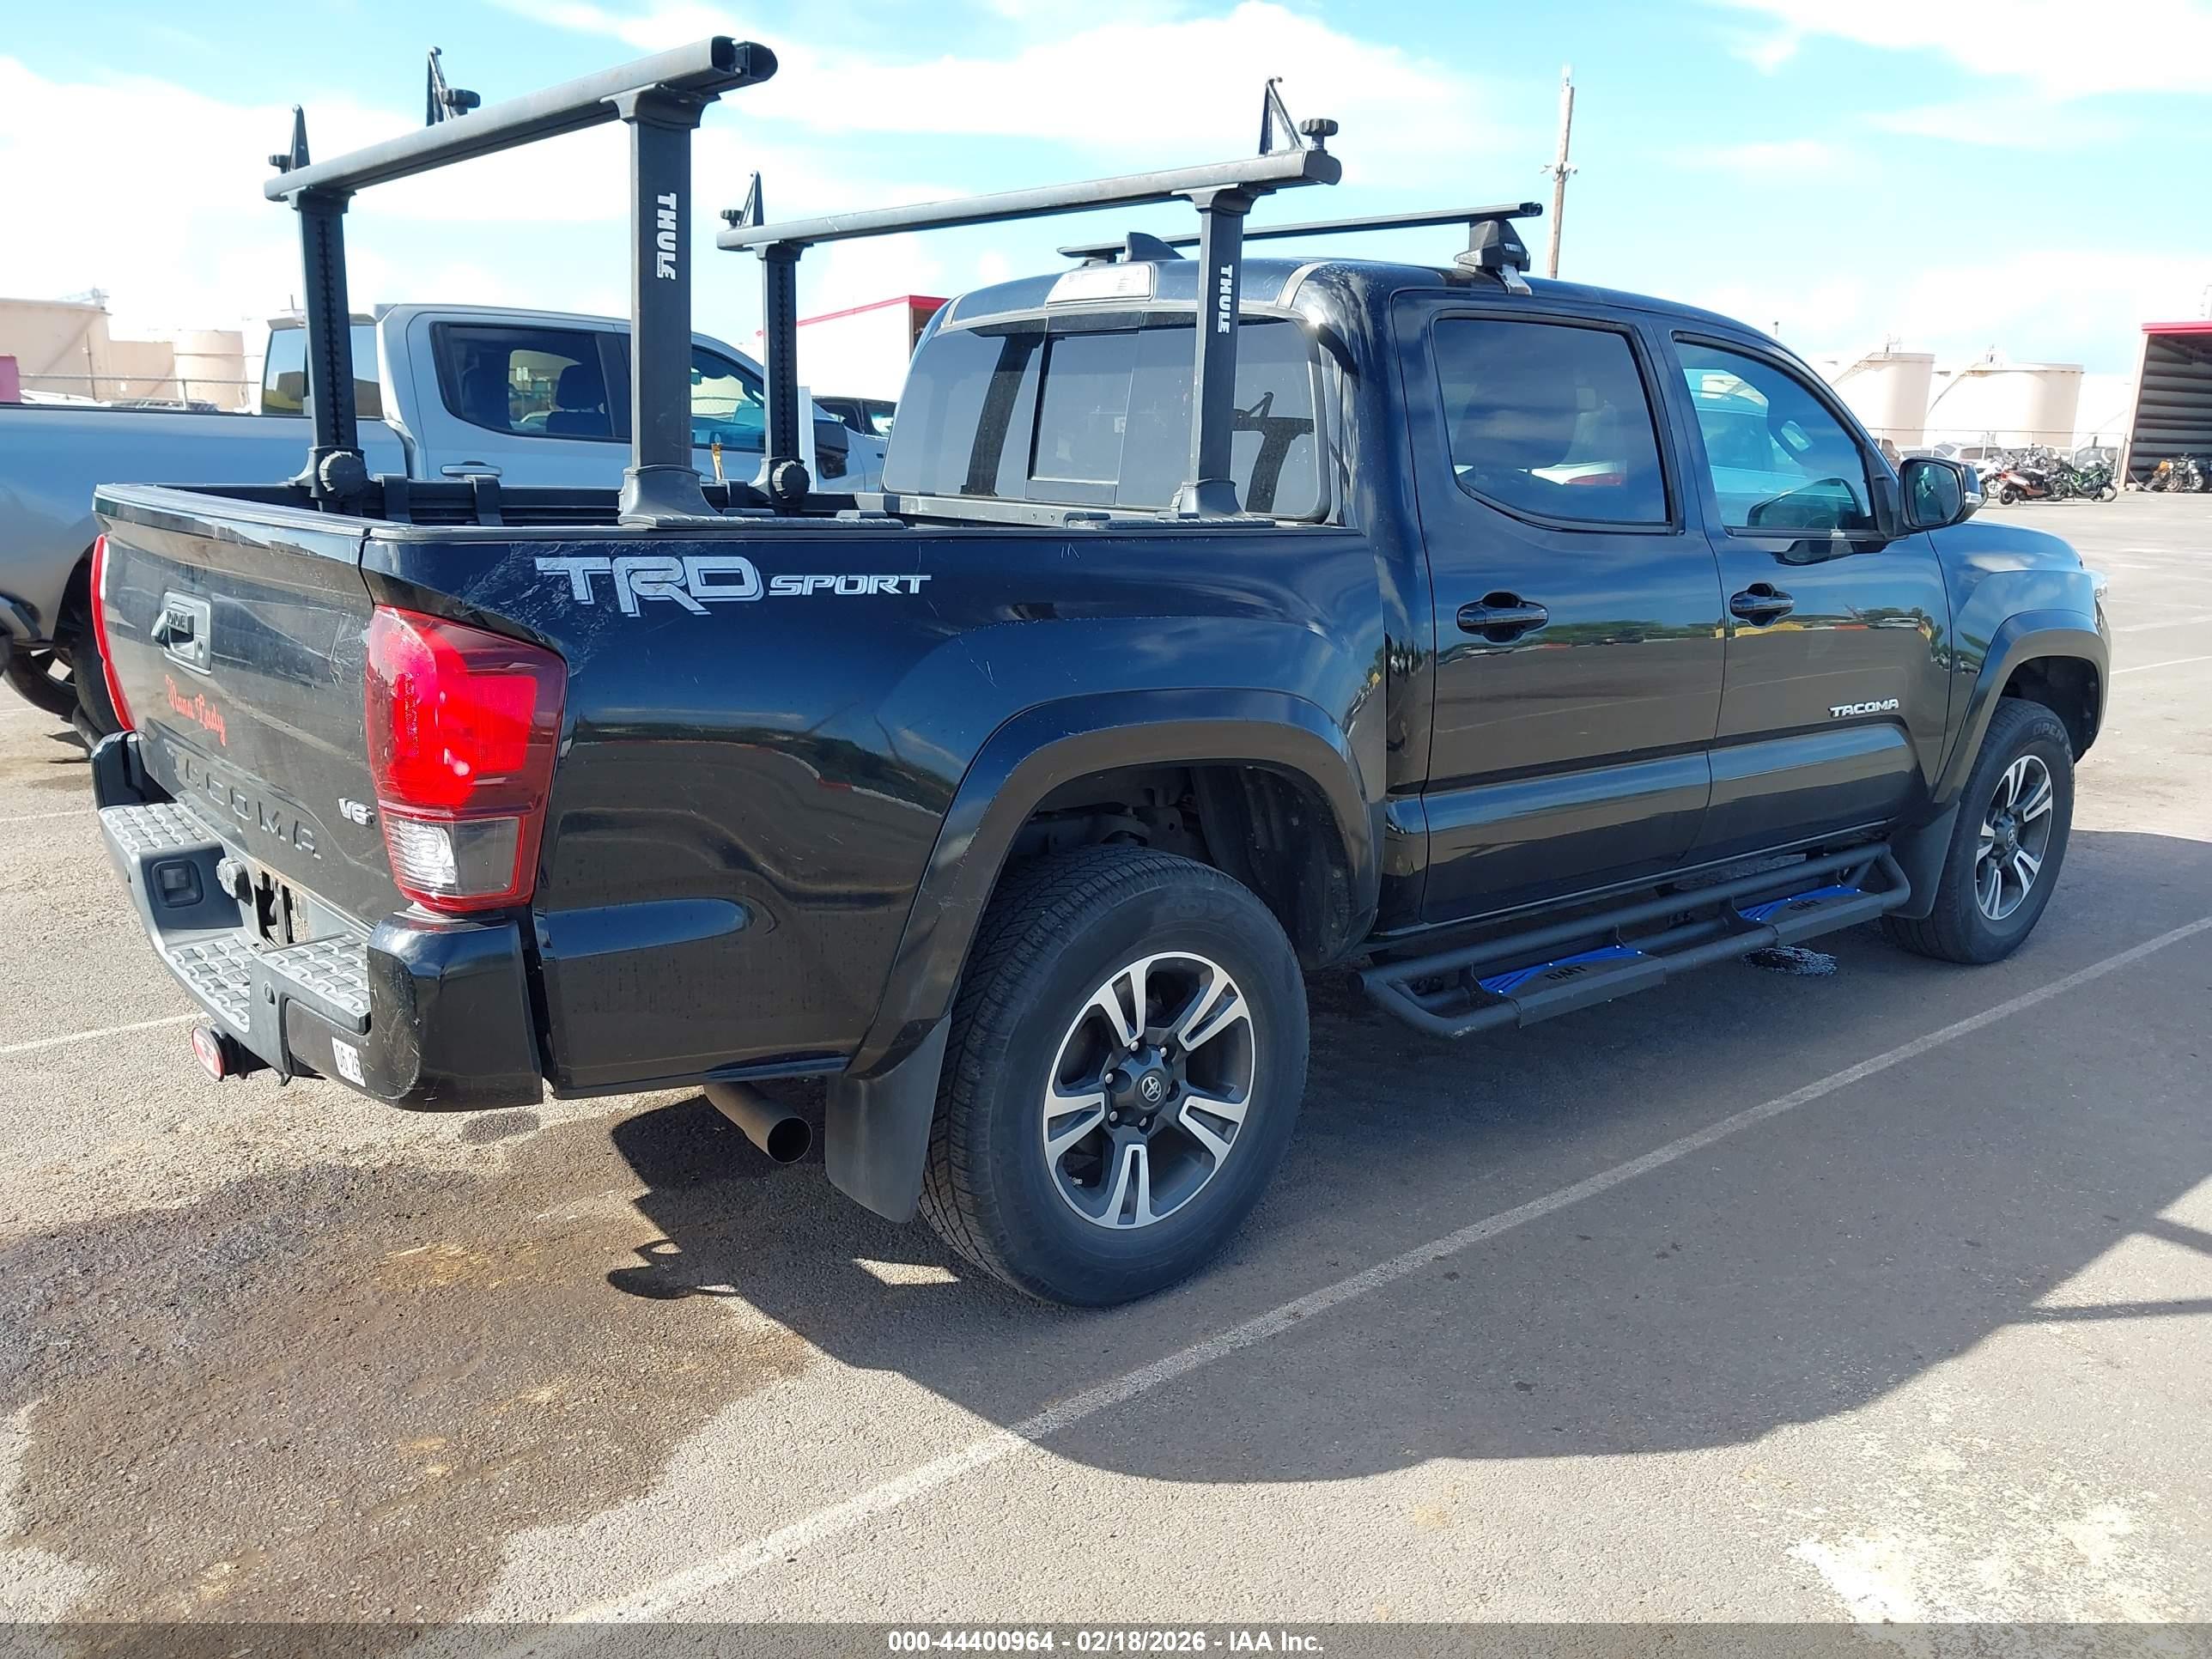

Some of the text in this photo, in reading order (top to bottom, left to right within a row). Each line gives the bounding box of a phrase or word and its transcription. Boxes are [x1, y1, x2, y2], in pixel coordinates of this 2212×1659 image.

[657, 192, 677, 280] THULE
[1217, 264, 1233, 334] THULE
[534, 556, 932, 617] TRD SPORT
[1829, 698, 1899, 718] TACOMA
[2033, 721, 2065, 742] OPEN
[165, 742, 322, 860] TACOMA
[337, 797, 376, 826] V6
[336, 1044, 363, 1079] 06 26
